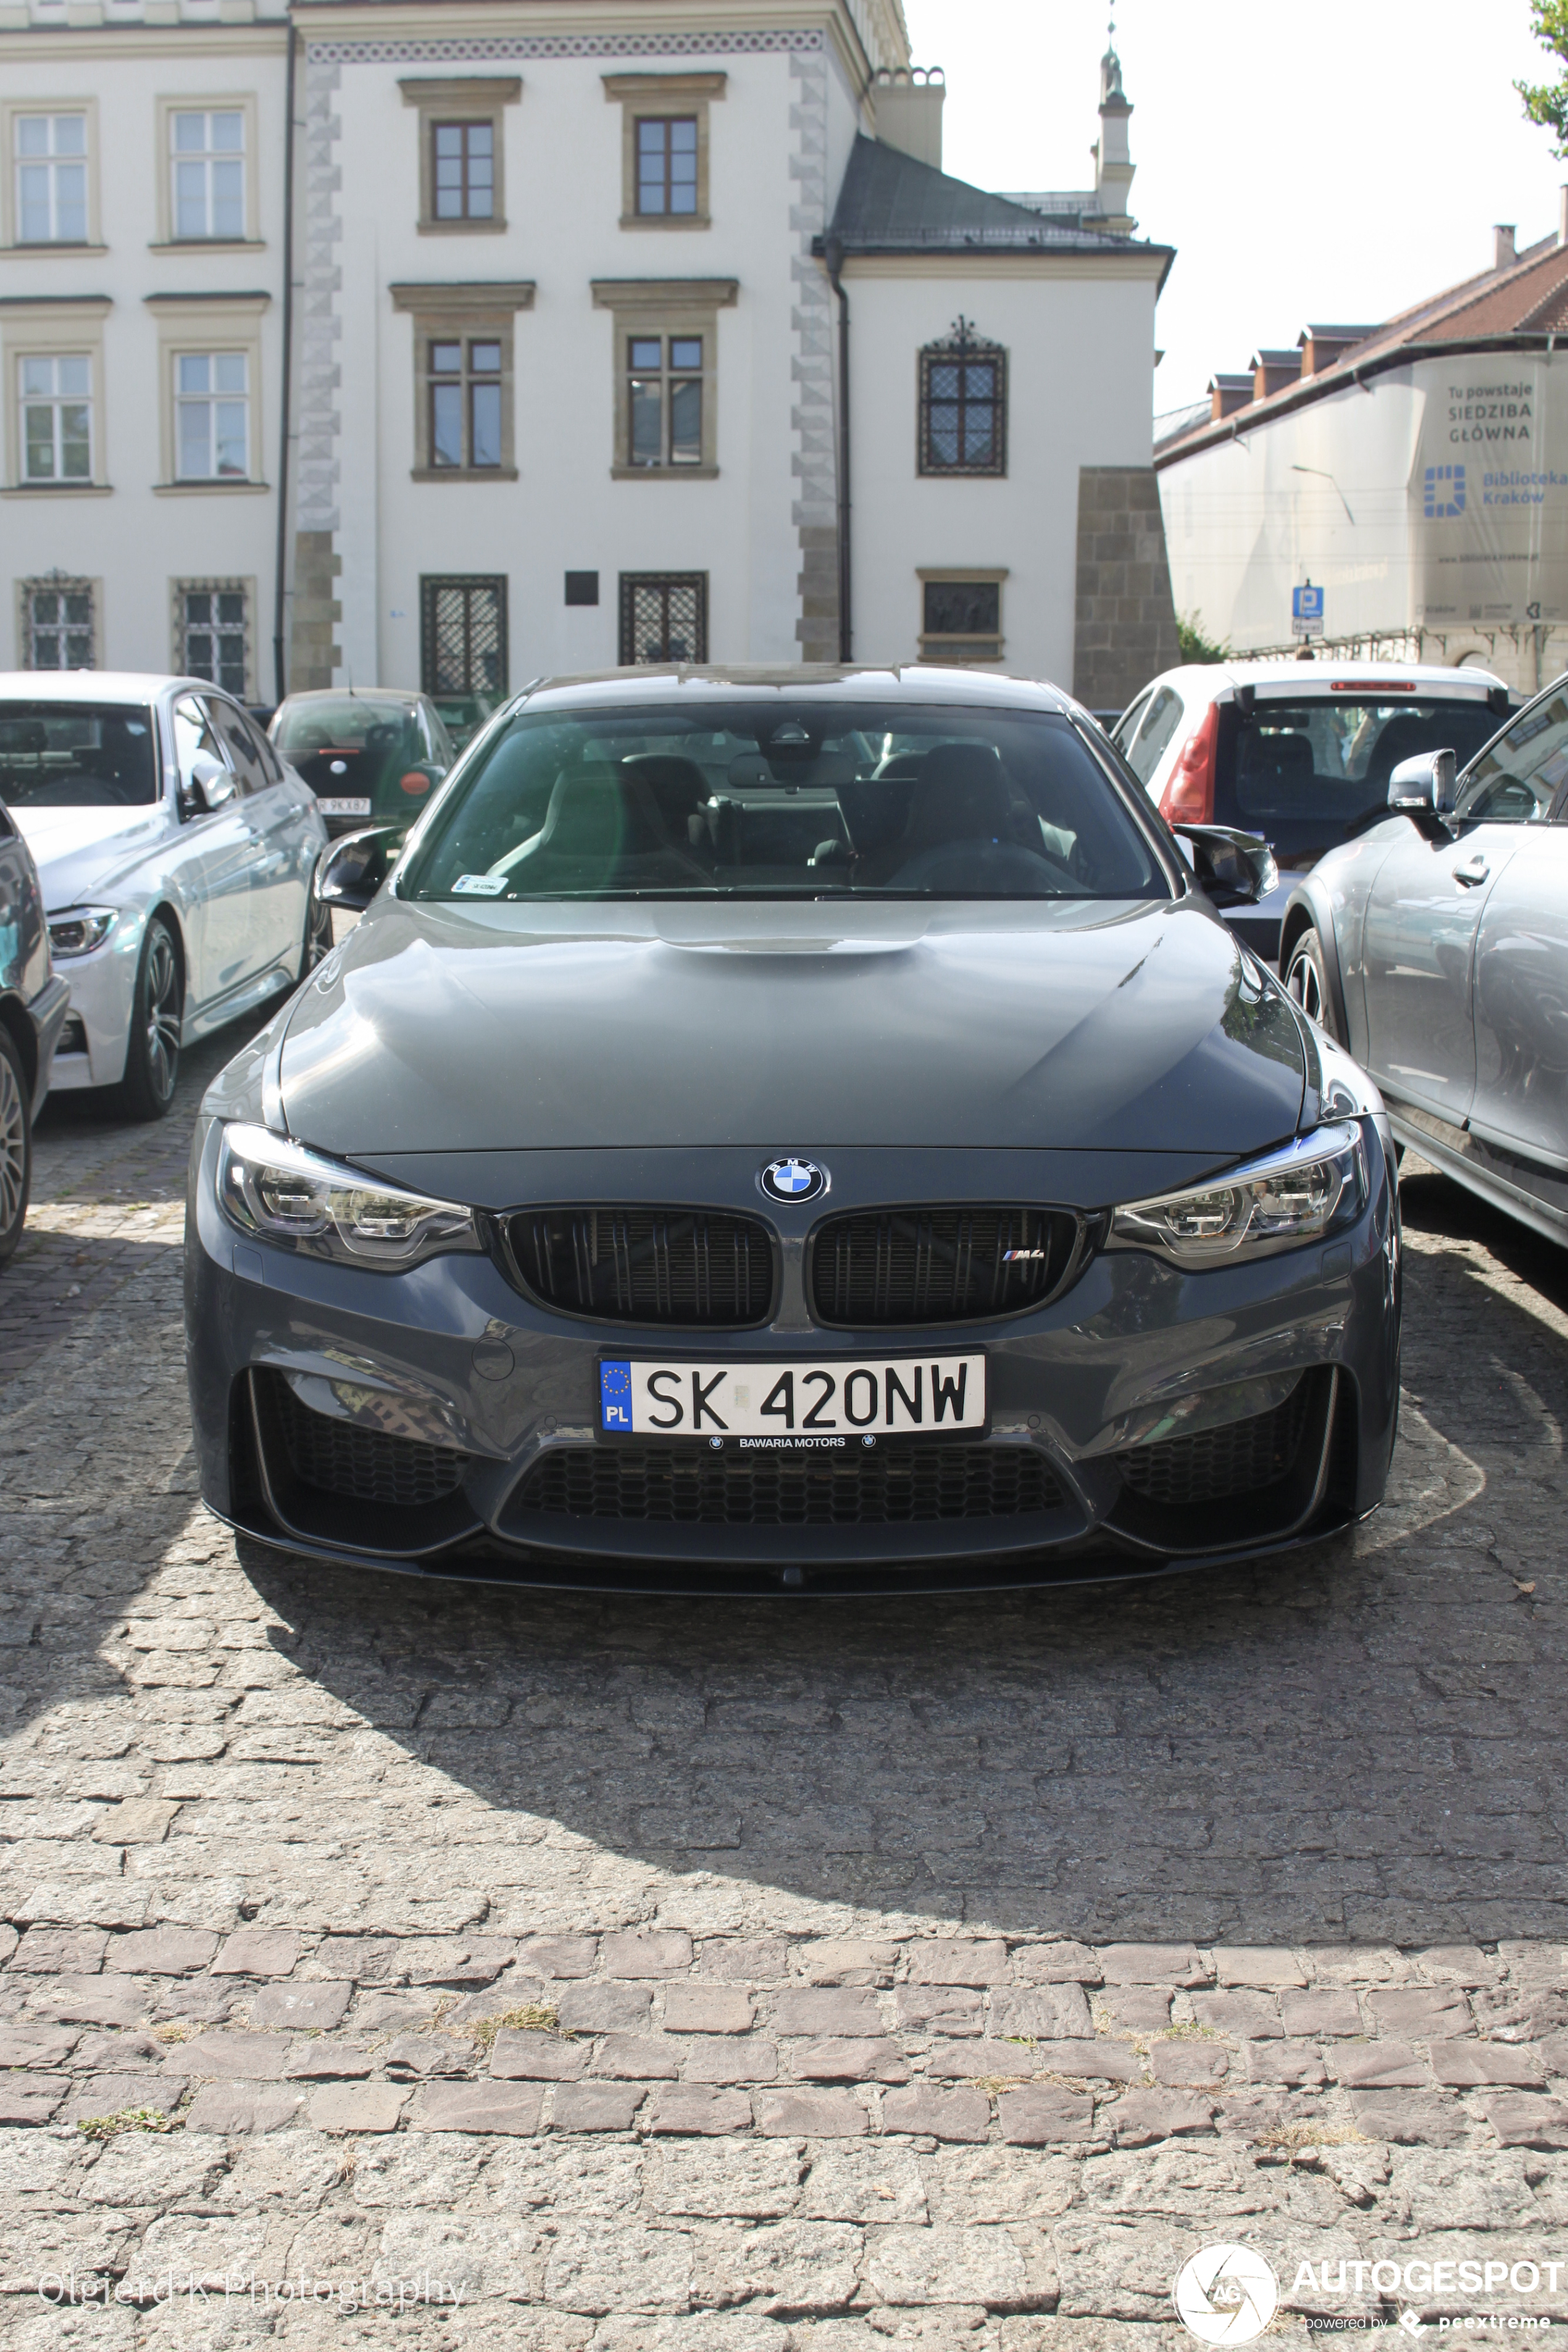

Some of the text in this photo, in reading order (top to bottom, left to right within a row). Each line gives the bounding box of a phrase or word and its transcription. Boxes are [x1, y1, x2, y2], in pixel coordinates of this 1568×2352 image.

[1448, 381, 1532, 400] Tu powstaje
[1448, 402, 1532, 421] SIEDZIBA
[1449, 422, 1530, 443] GŁÓWNA
[1483, 470, 1568, 486] Biblioteka
[1483, 489, 1545, 504] Kraków
[768, 1159, 818, 1173] BMW
[1014, 1249, 1044, 1260] M4
[647, 1362, 967, 1430] SK 420NW
[606, 1406, 628, 1423] PL
[740, 1437, 846, 1448] BAWARIA MOTORS
